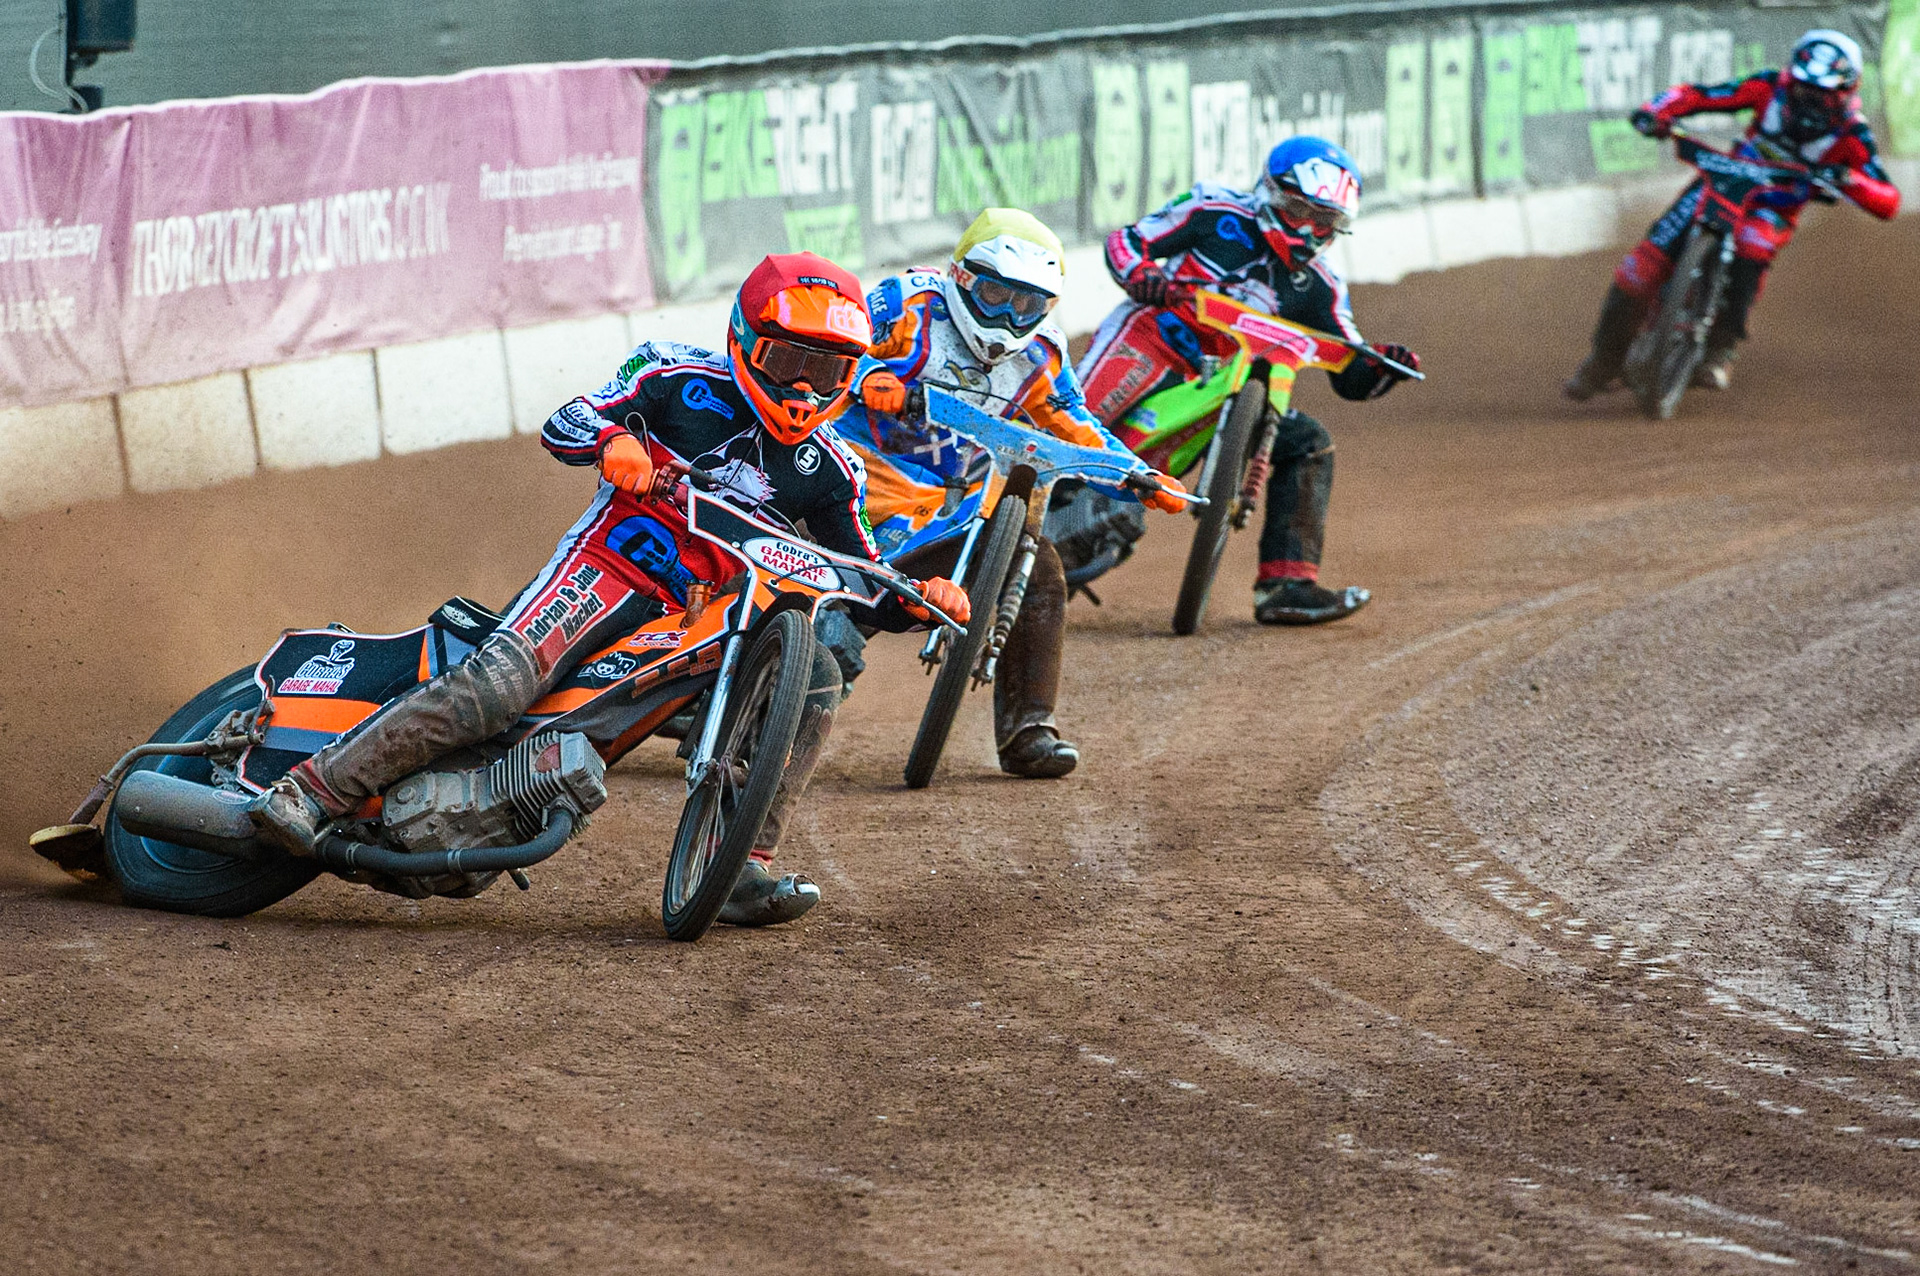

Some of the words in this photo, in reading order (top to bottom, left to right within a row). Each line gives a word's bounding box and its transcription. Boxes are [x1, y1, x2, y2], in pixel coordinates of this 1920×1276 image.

[761, 546, 828, 578] GARAGE
[776, 541, 818, 564] Cobra's
[524, 599, 569, 646] Adrian
[571, 565, 600, 591] Jane
[280, 680, 313, 692] GARAGE
[310, 680, 339, 693] MAHAL
